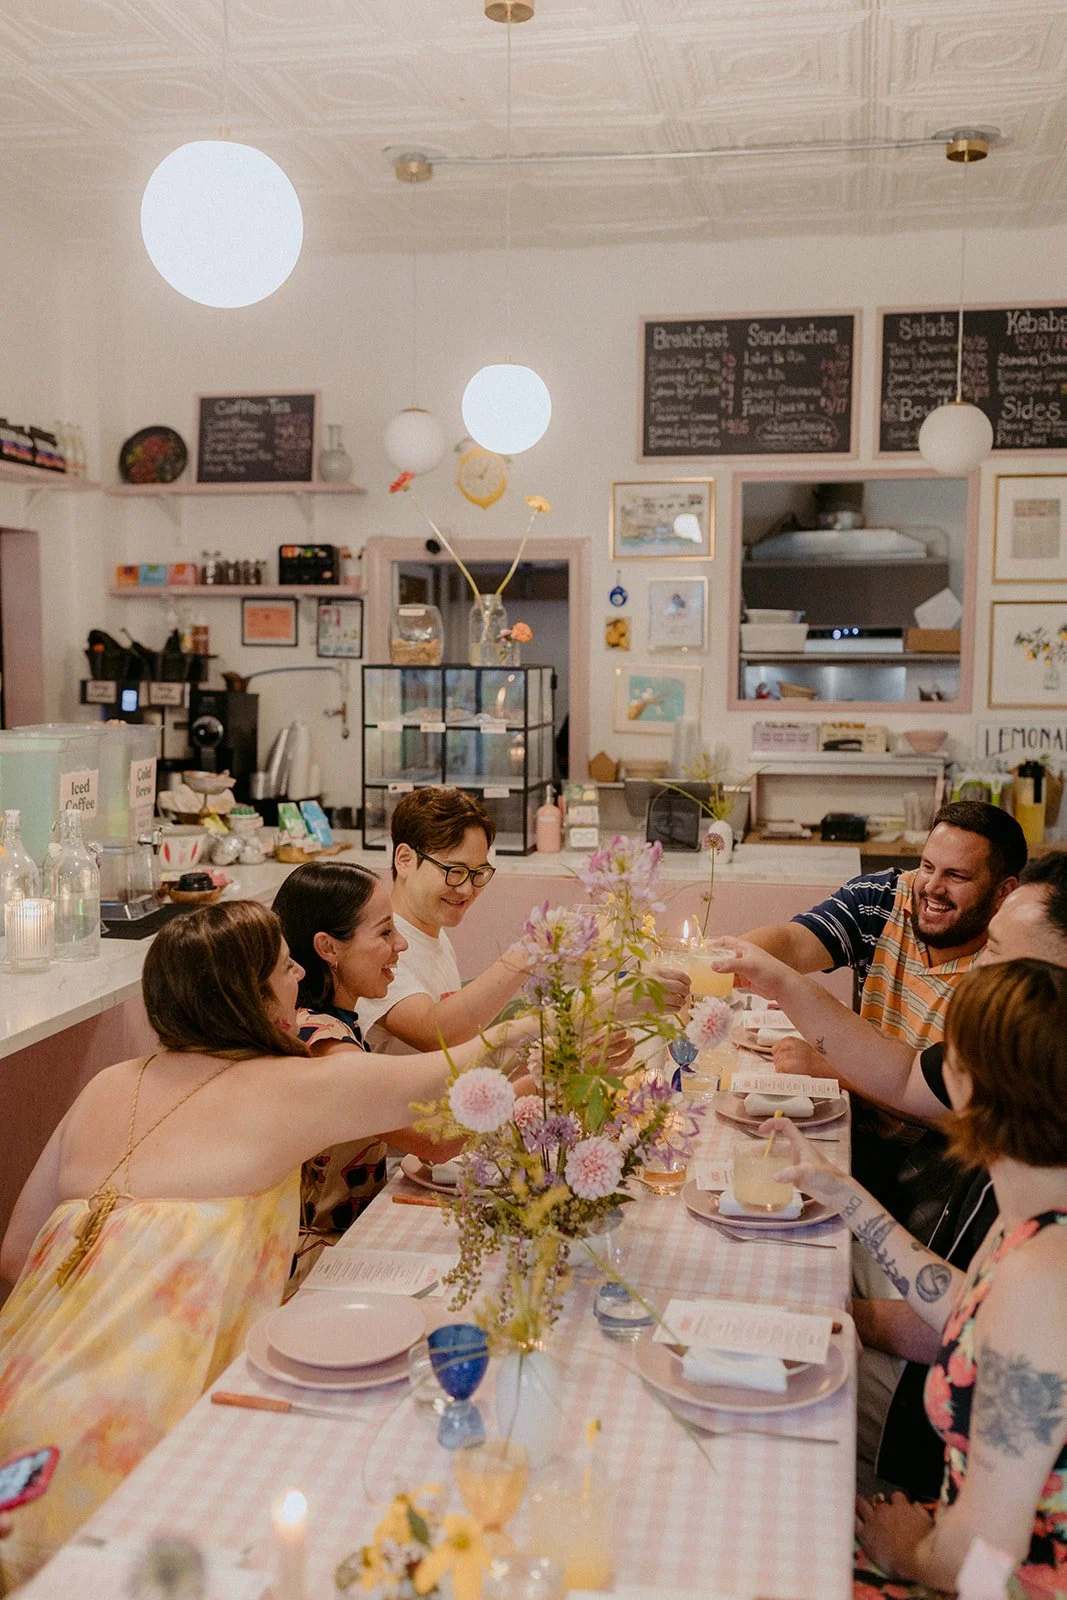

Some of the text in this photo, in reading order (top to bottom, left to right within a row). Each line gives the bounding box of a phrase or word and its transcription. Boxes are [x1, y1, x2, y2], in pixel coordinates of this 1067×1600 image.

[653, 325, 729, 350] Breakfast
[748, 322, 838, 347] Sandwiches
[899, 316, 955, 341] Salads
[1001, 396, 1060, 421] Sides
[985, 727, 1067, 757] LEMONA
[137, 766, 152, 781] Cold
[71, 778, 90, 796] Iced
[136, 785, 152, 798] Brew
[65, 796, 95, 811] Coffee
